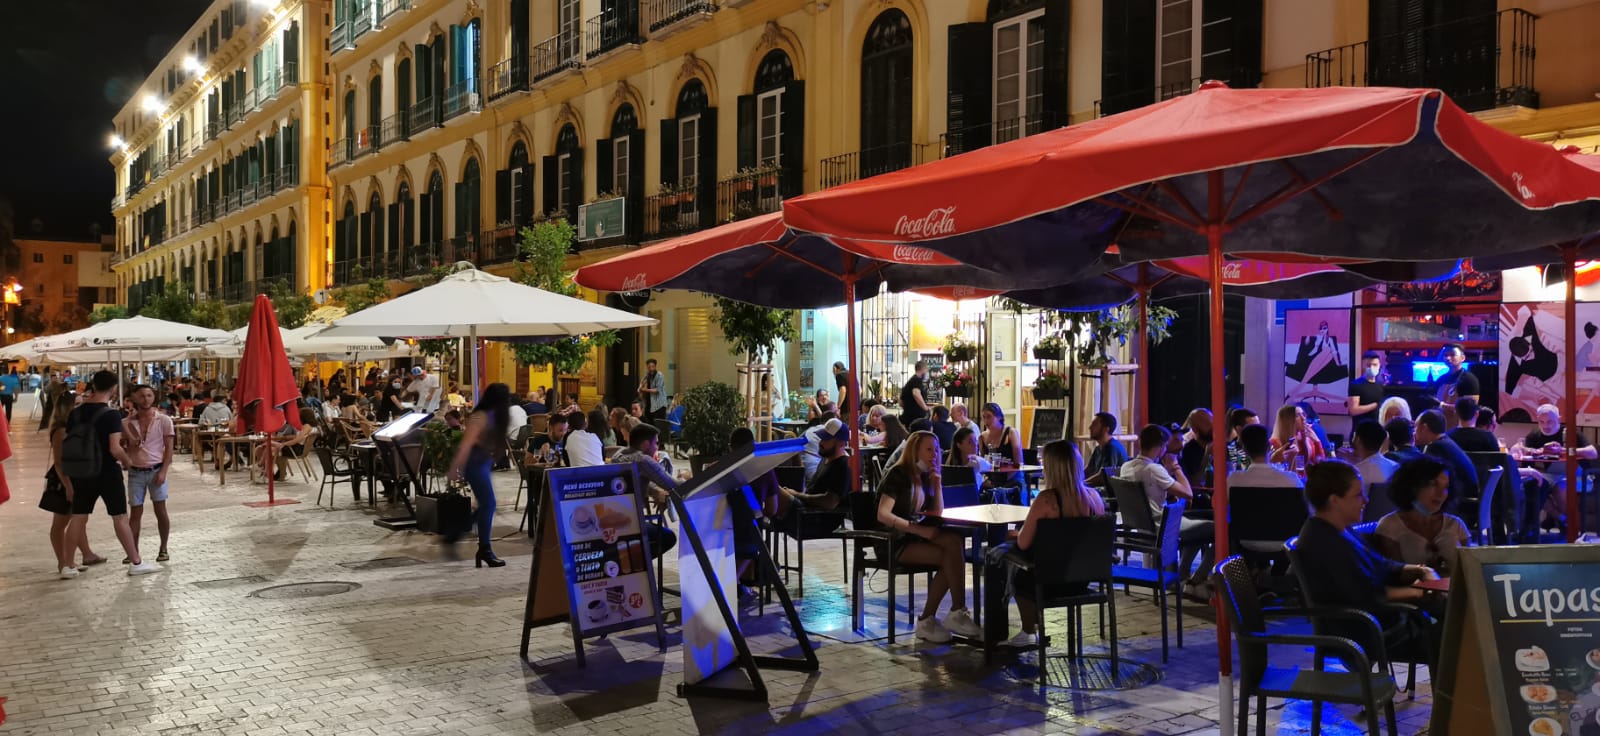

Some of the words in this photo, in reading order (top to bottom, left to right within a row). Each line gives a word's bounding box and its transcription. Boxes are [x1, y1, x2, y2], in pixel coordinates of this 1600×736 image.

[894, 206, 956, 238] Coca-Cola
[575, 550, 604, 562] CERVEZA
[1493, 573, 1600, 627] Tapas
